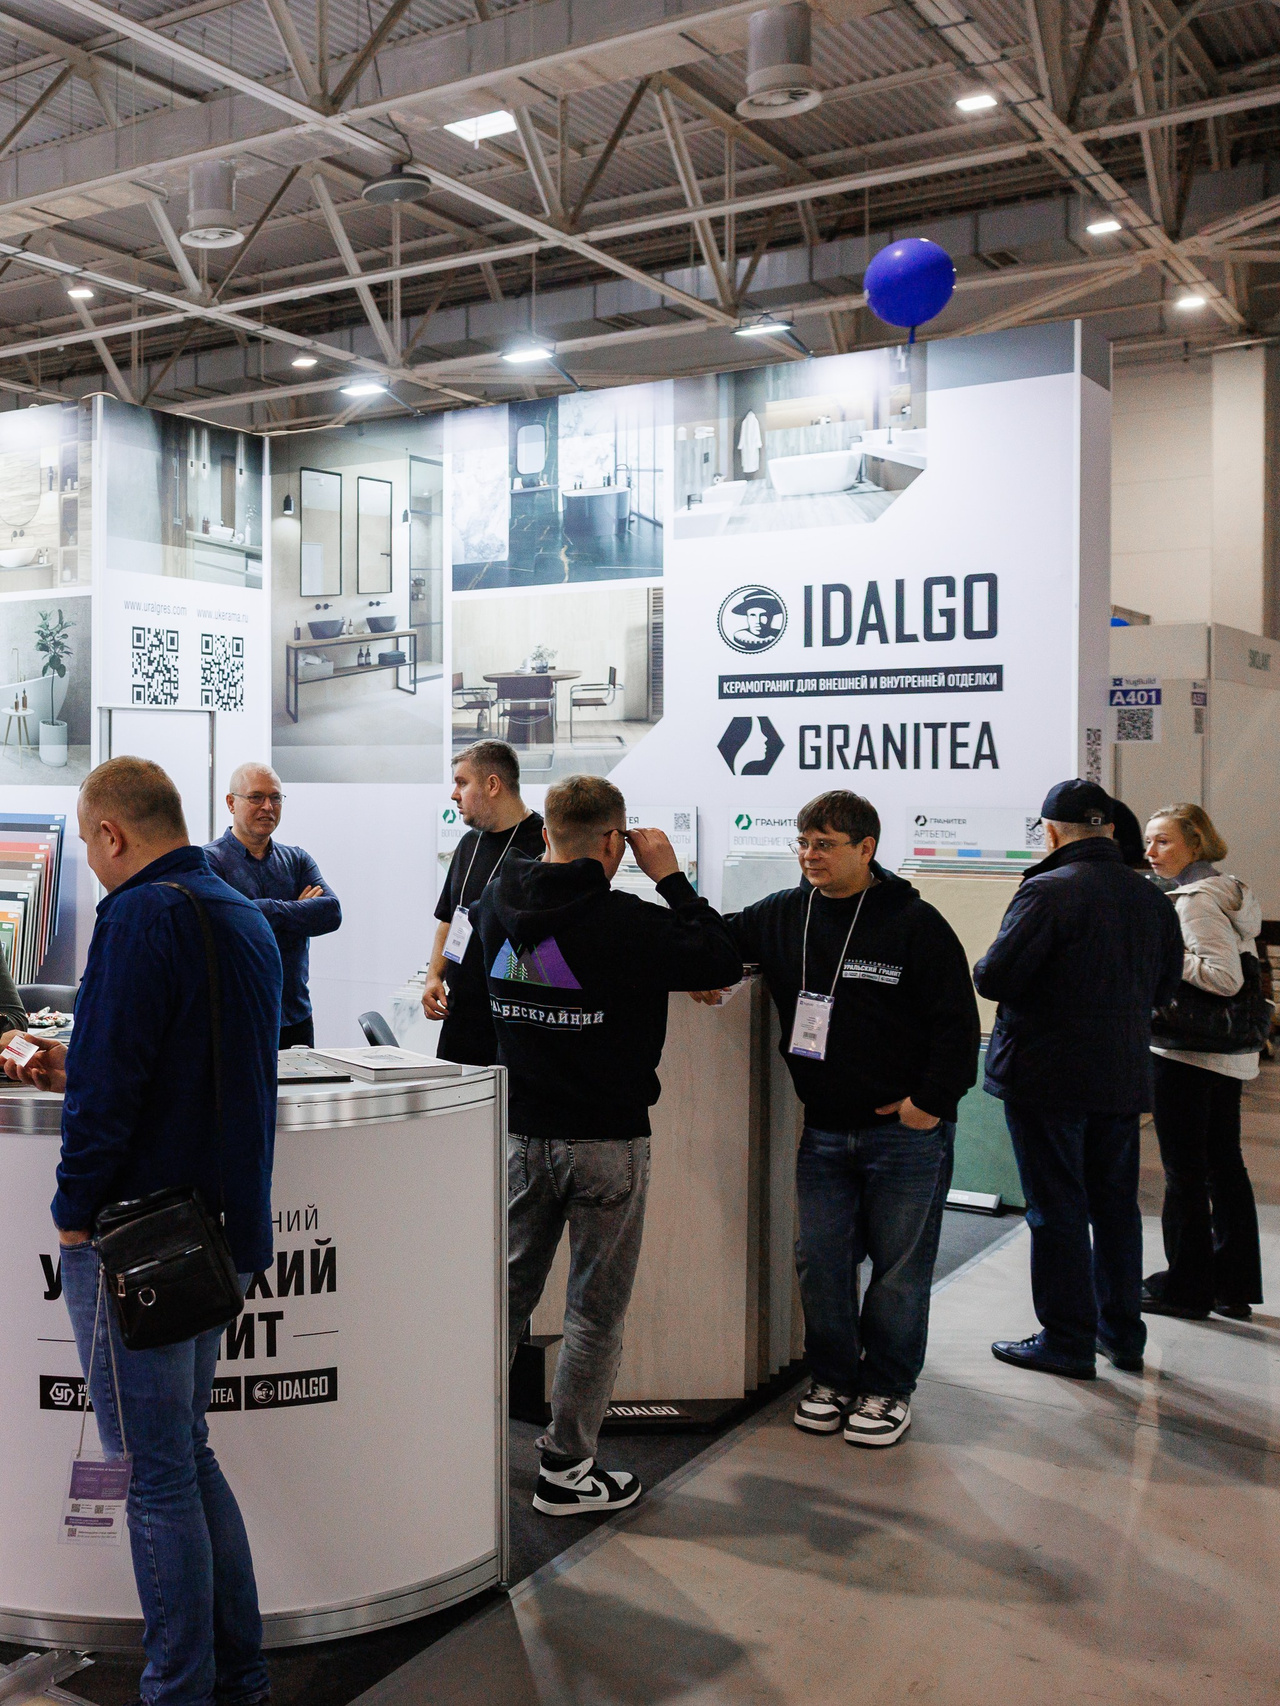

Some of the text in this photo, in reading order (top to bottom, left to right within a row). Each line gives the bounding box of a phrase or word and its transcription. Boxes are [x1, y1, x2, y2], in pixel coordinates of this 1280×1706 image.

[124, 600, 187, 617] www.uralgres.com
[804, 573, 998, 647] IDALGO
[723, 672, 998, 694] КЕРАМОГРАНИТ ДЛЯ ВНЕШНЕЙ И ВНУТРЕННЕЙ ОТДЕЛКИ
[1125, 678, 1157, 686] YugBuild
[1112, 690, 1157, 705] A401
[799, 721, 1000, 770] GRANITEA
[755, 818, 797, 827] ГРАНИТЕ
[914, 829, 956, 839] АРТБЕТОН
[502, 1004, 605, 1025] БЕСКРАЙНИЙ
[278, 1376, 329, 1400] IDALGO
[612, 1406, 680, 1416] IDALGO
